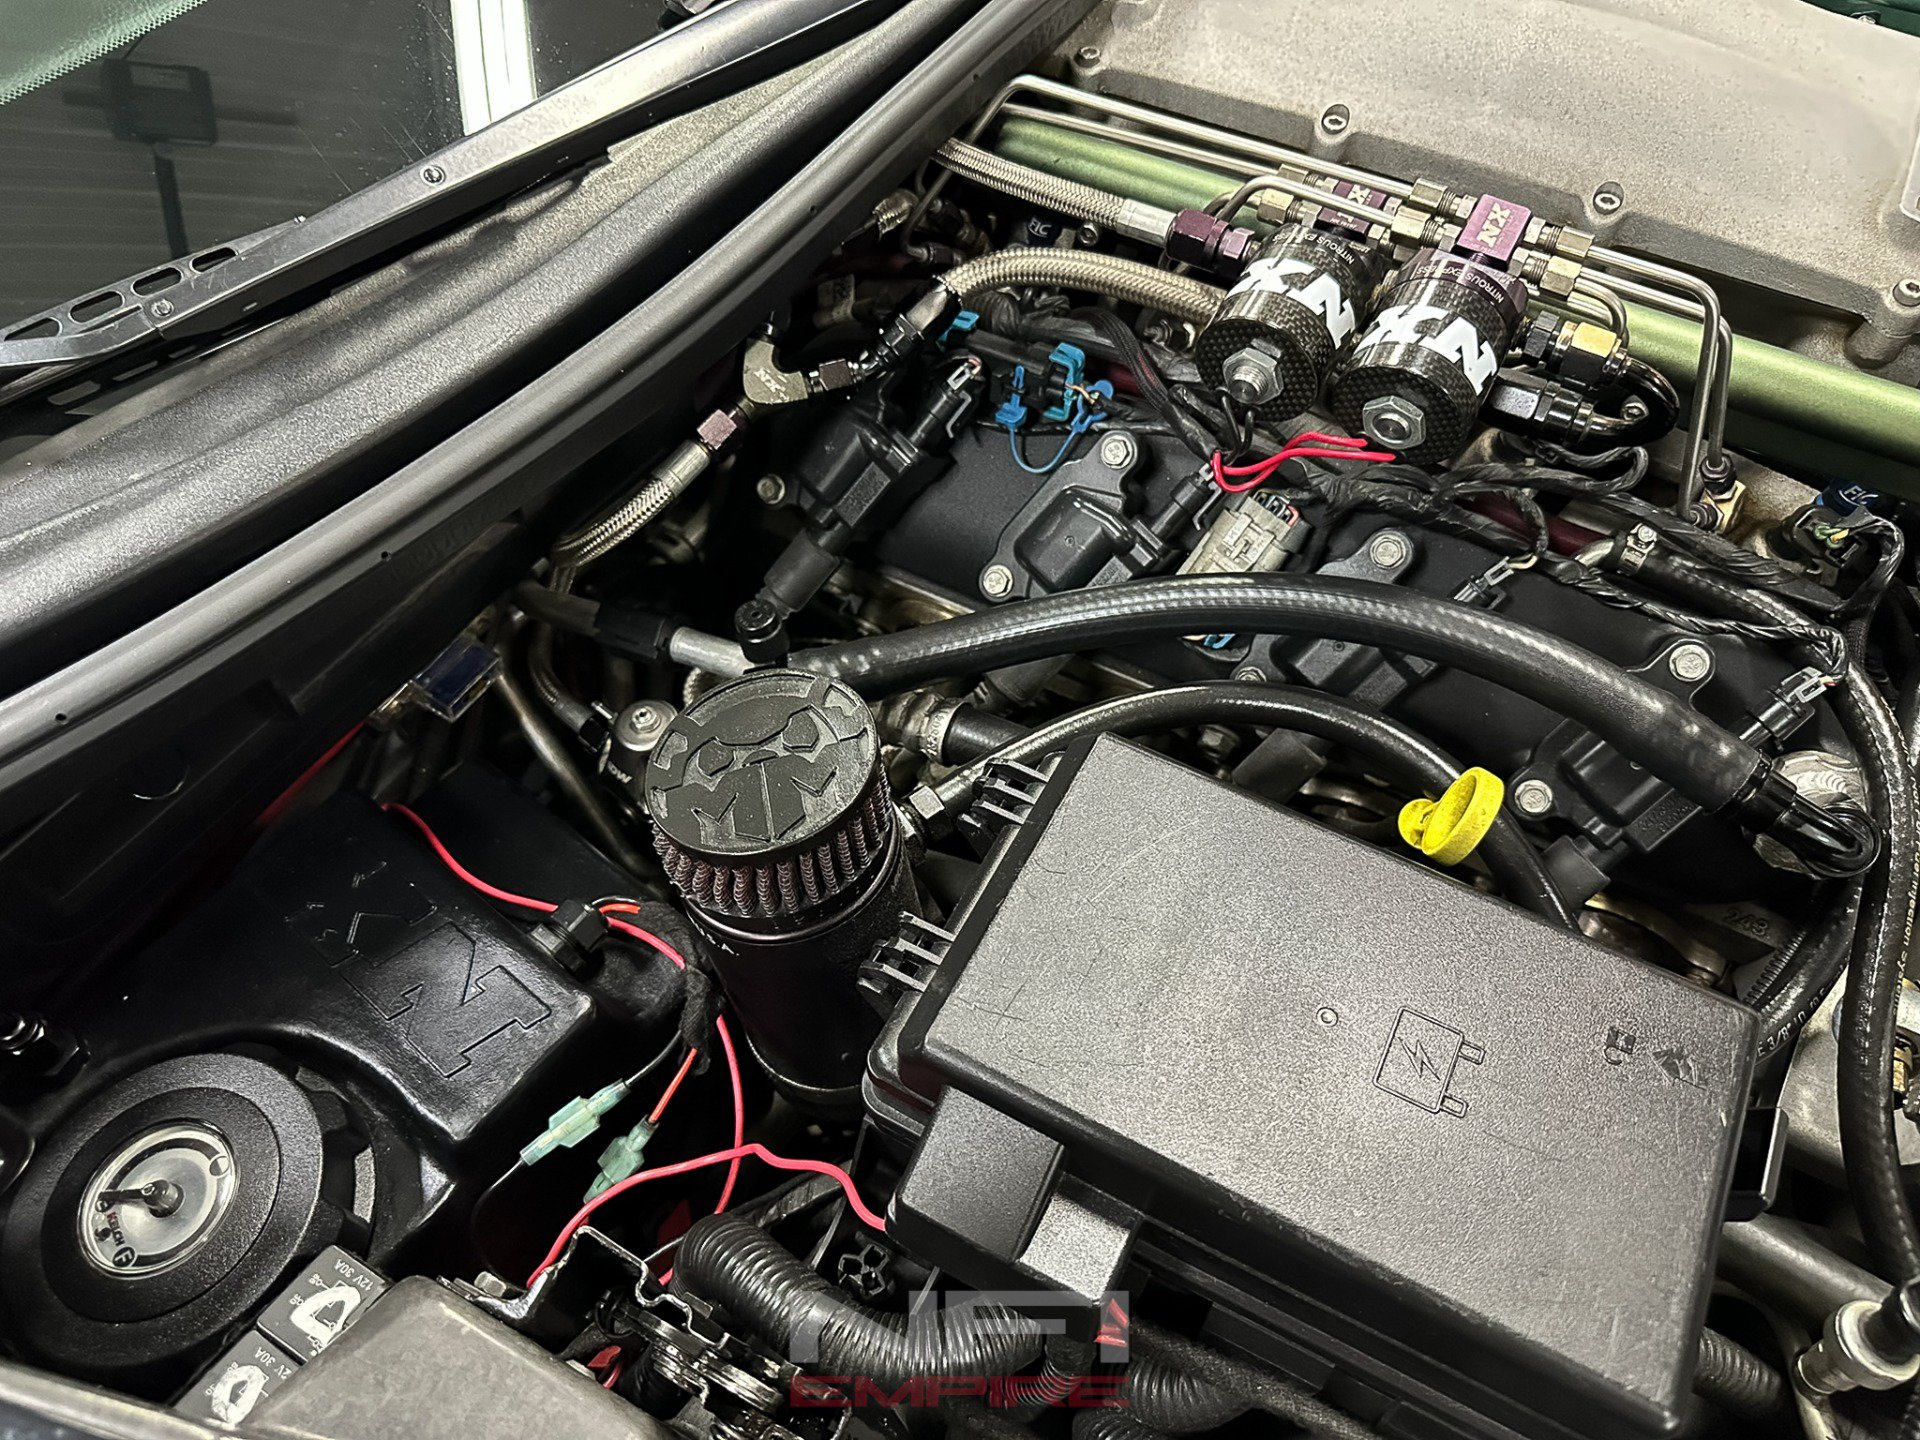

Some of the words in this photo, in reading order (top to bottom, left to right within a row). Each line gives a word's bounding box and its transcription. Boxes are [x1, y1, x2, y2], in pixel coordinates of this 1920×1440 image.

[1028, 217, 1052, 236] FIC
[1476, 202, 1511, 248] NX
[1272, 230, 1316, 245] EXESS
[1316, 237, 1355, 265] NITROUS
[1416, 265, 1462, 279] EXPESS
[1465, 272, 1505, 304] NITROUS
[114, 1250, 133, 1263] F
[334, 1258, 355, 1278] 30A
[352, 1274, 374, 1291] 12V
[254, 1346, 276, 1367] 30A
[273, 1363, 293, 1380] 2V
